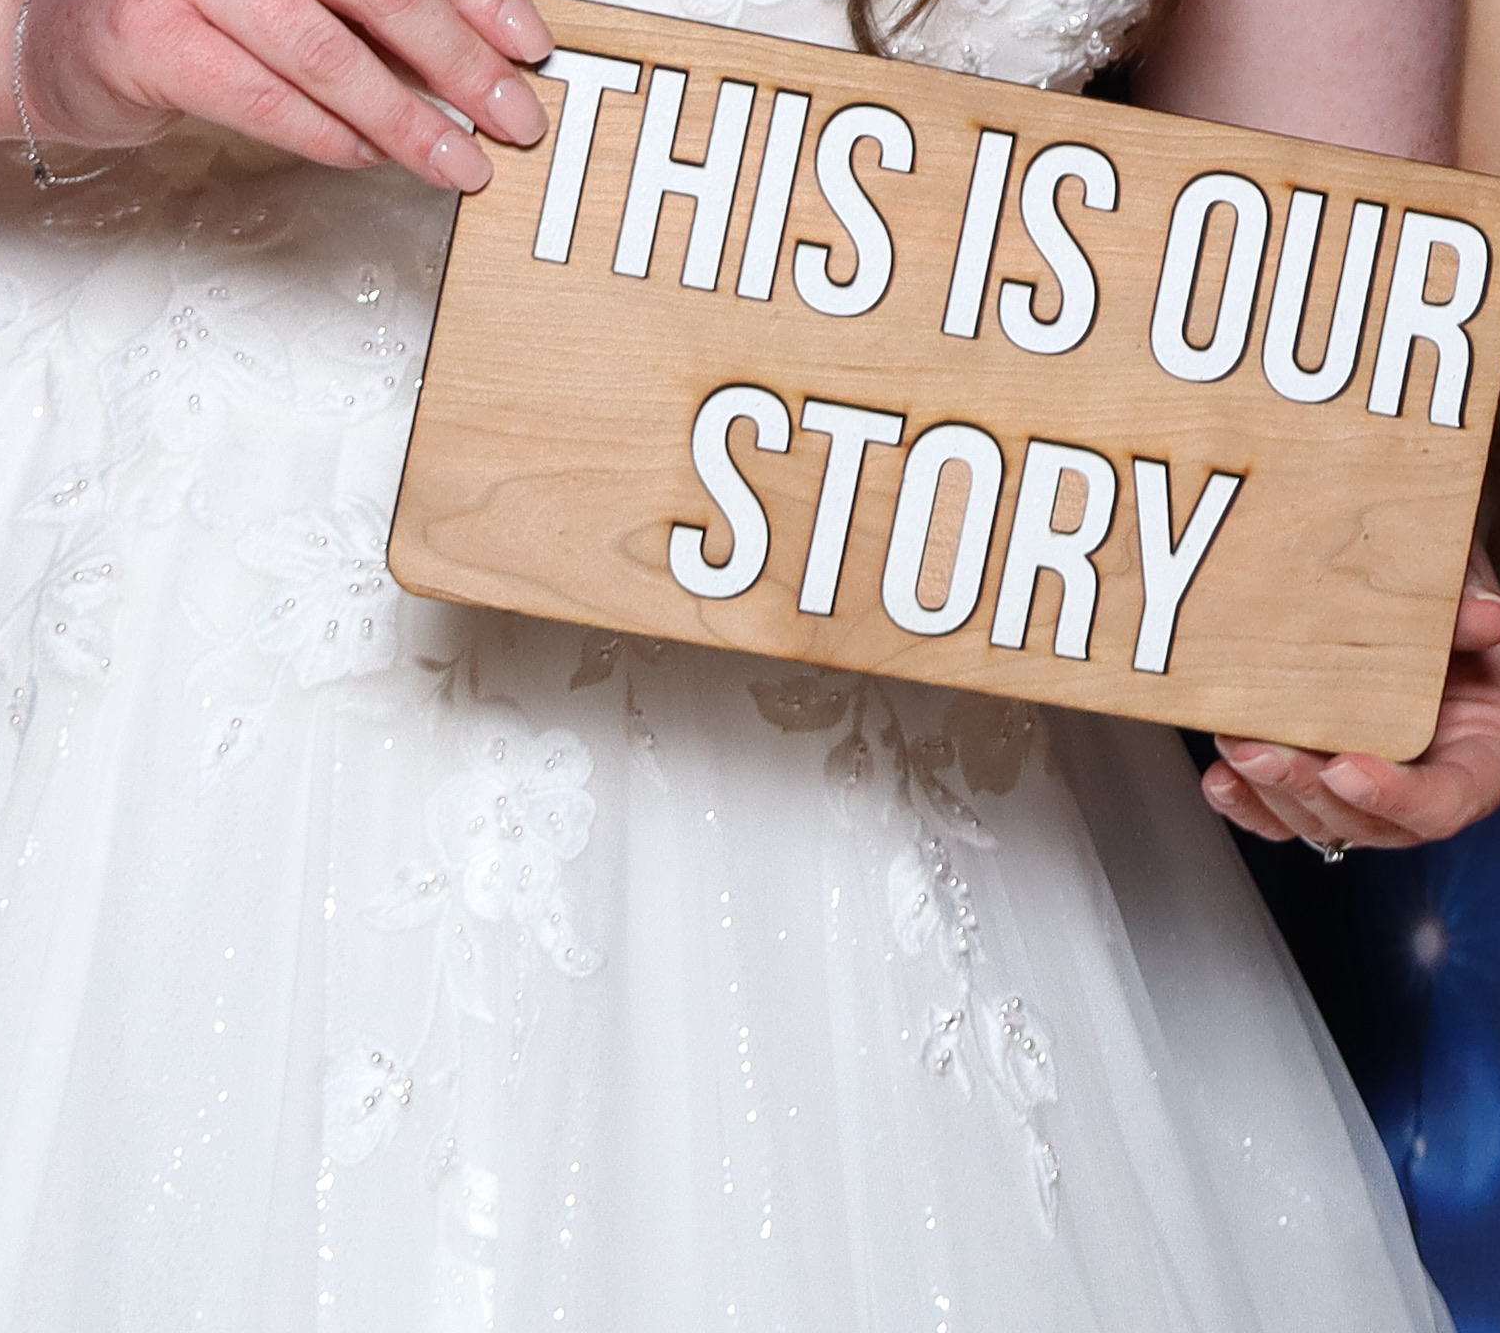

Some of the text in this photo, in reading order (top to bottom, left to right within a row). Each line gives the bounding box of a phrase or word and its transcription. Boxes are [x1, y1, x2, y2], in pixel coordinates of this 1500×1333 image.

[533, 49, 1491, 428] THIS IS OUR
[668, 384, 1245, 674] STORY
